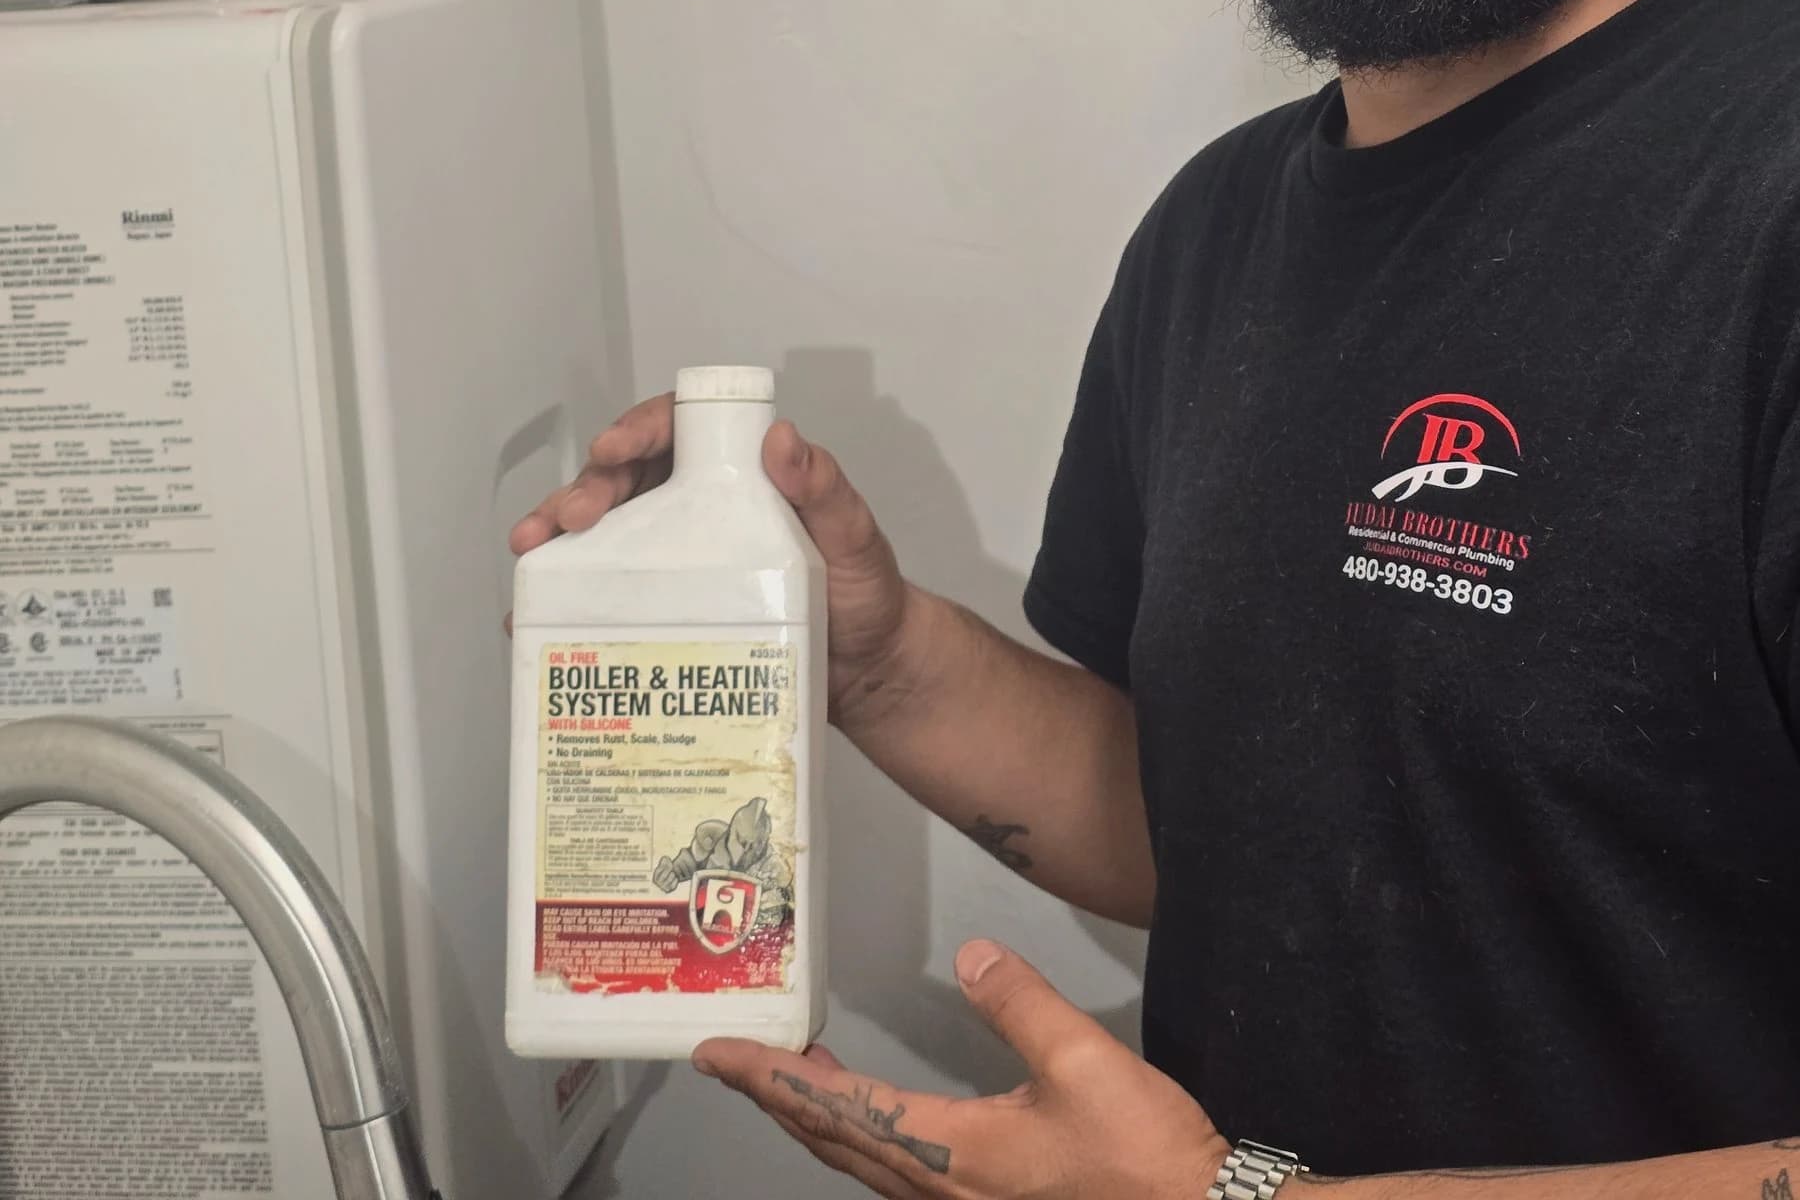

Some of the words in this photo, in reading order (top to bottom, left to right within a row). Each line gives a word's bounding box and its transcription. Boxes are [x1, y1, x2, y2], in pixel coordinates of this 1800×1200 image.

[122, 208, 173, 224] Rinnai
[1345, 502, 1396, 528] JUDAI
[1402, 509, 1531, 559] BROTHERS
[1348, 525, 1390, 541] Residential
[1390, 532, 1397, 542] &
[1398, 533, 1456, 555] Commercial
[1458, 546, 1516, 572] Plumbing
[1343, 555, 1514, 615] 480-938-3803
[549, 652, 567, 664] OIL
[570, 652, 599, 664] FREE
[549, 666, 639, 690] BOILER
[650, 665, 668, 690] &
[678, 665, 789, 689] HEATING
[548, 692, 650, 717] SYSTEM
[662, 692, 778, 717] CLEANER
[547, 718, 577, 730] WITH
[580, 718, 633, 730] SILICONE
[556, 734, 600, 744] Removes
[603, 734, 628, 746] Rust,
[631, 734, 660, 746] Scale,
[663, 734, 696, 746] Sludge
[556, 749, 570, 758] No
[572, 748, 613, 760] Draining
[560, 908, 582, 916] CAUSE
